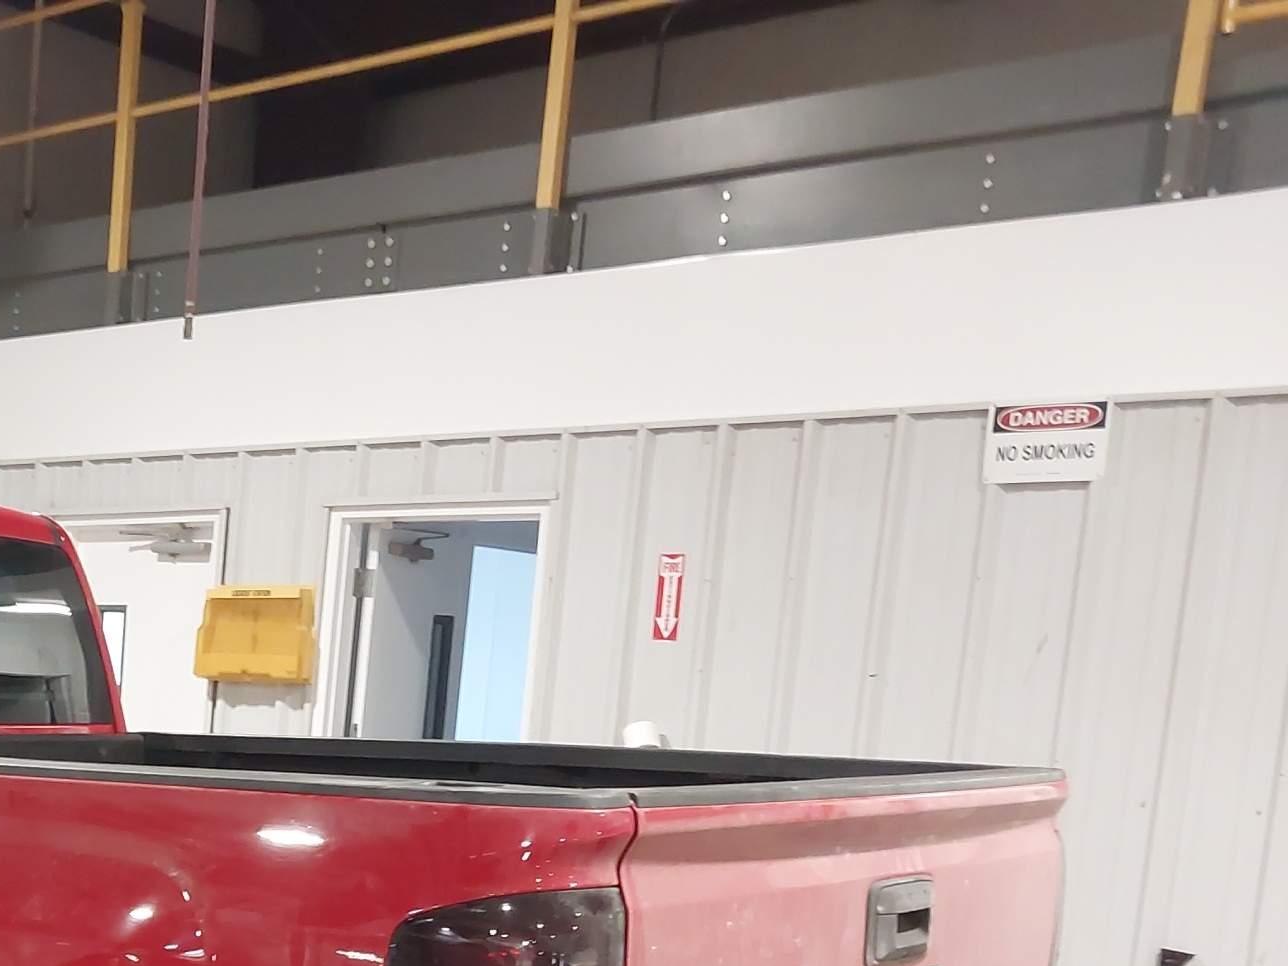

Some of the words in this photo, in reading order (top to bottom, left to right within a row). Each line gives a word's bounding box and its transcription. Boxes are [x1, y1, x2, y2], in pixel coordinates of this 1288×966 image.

[1008, 407, 1090, 427] DANGER
[996, 445, 1017, 462] NO
[1022, 442, 1095, 461] SMOKING
